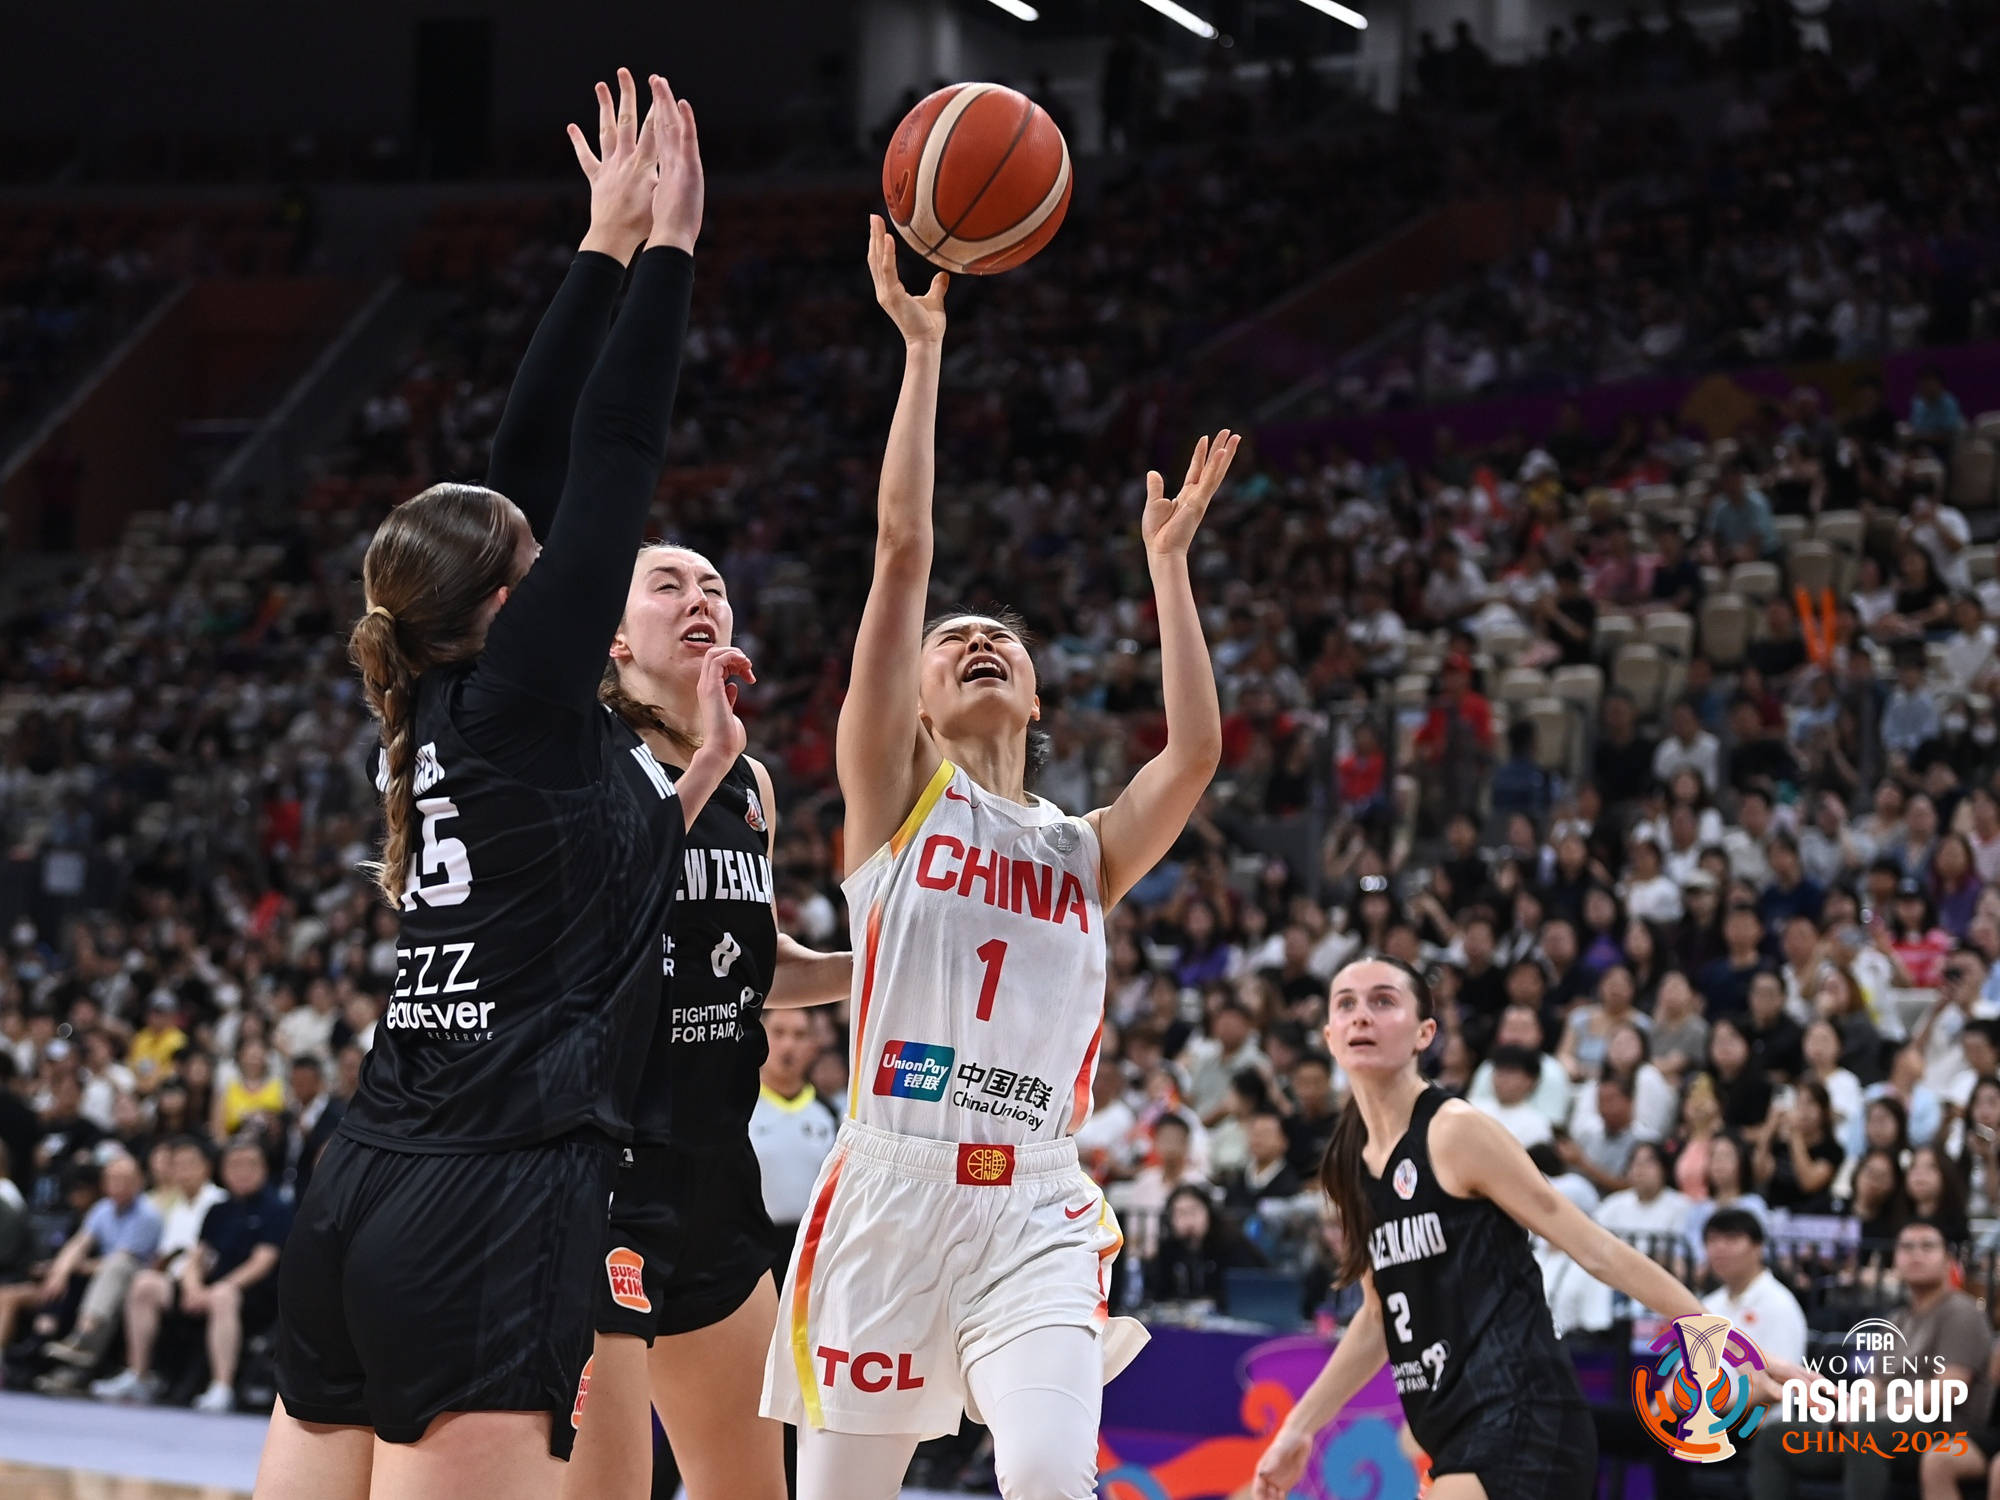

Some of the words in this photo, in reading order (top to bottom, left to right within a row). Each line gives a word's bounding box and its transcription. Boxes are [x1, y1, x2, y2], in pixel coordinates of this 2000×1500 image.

[675, 848, 708, 901] W
[916, 833, 1089, 934] CHINA
[976, 938, 1008, 1022] 1
[671, 1002, 738, 1025] FIGHTING
[427, 1031, 494, 1042] RESERVE
[671, 1026, 706, 1044] FOR
[709, 1021, 736, 1041] FAIR
[882, 1053, 950, 1081] UnionPay
[903, 1072, 941, 1091] 银联
[953, 1091, 990, 1113] China
[612, 1278, 647, 1299] KIN
[1386, 1291, 1413, 1343] 2
[816, 1345, 925, 1393] TCL
